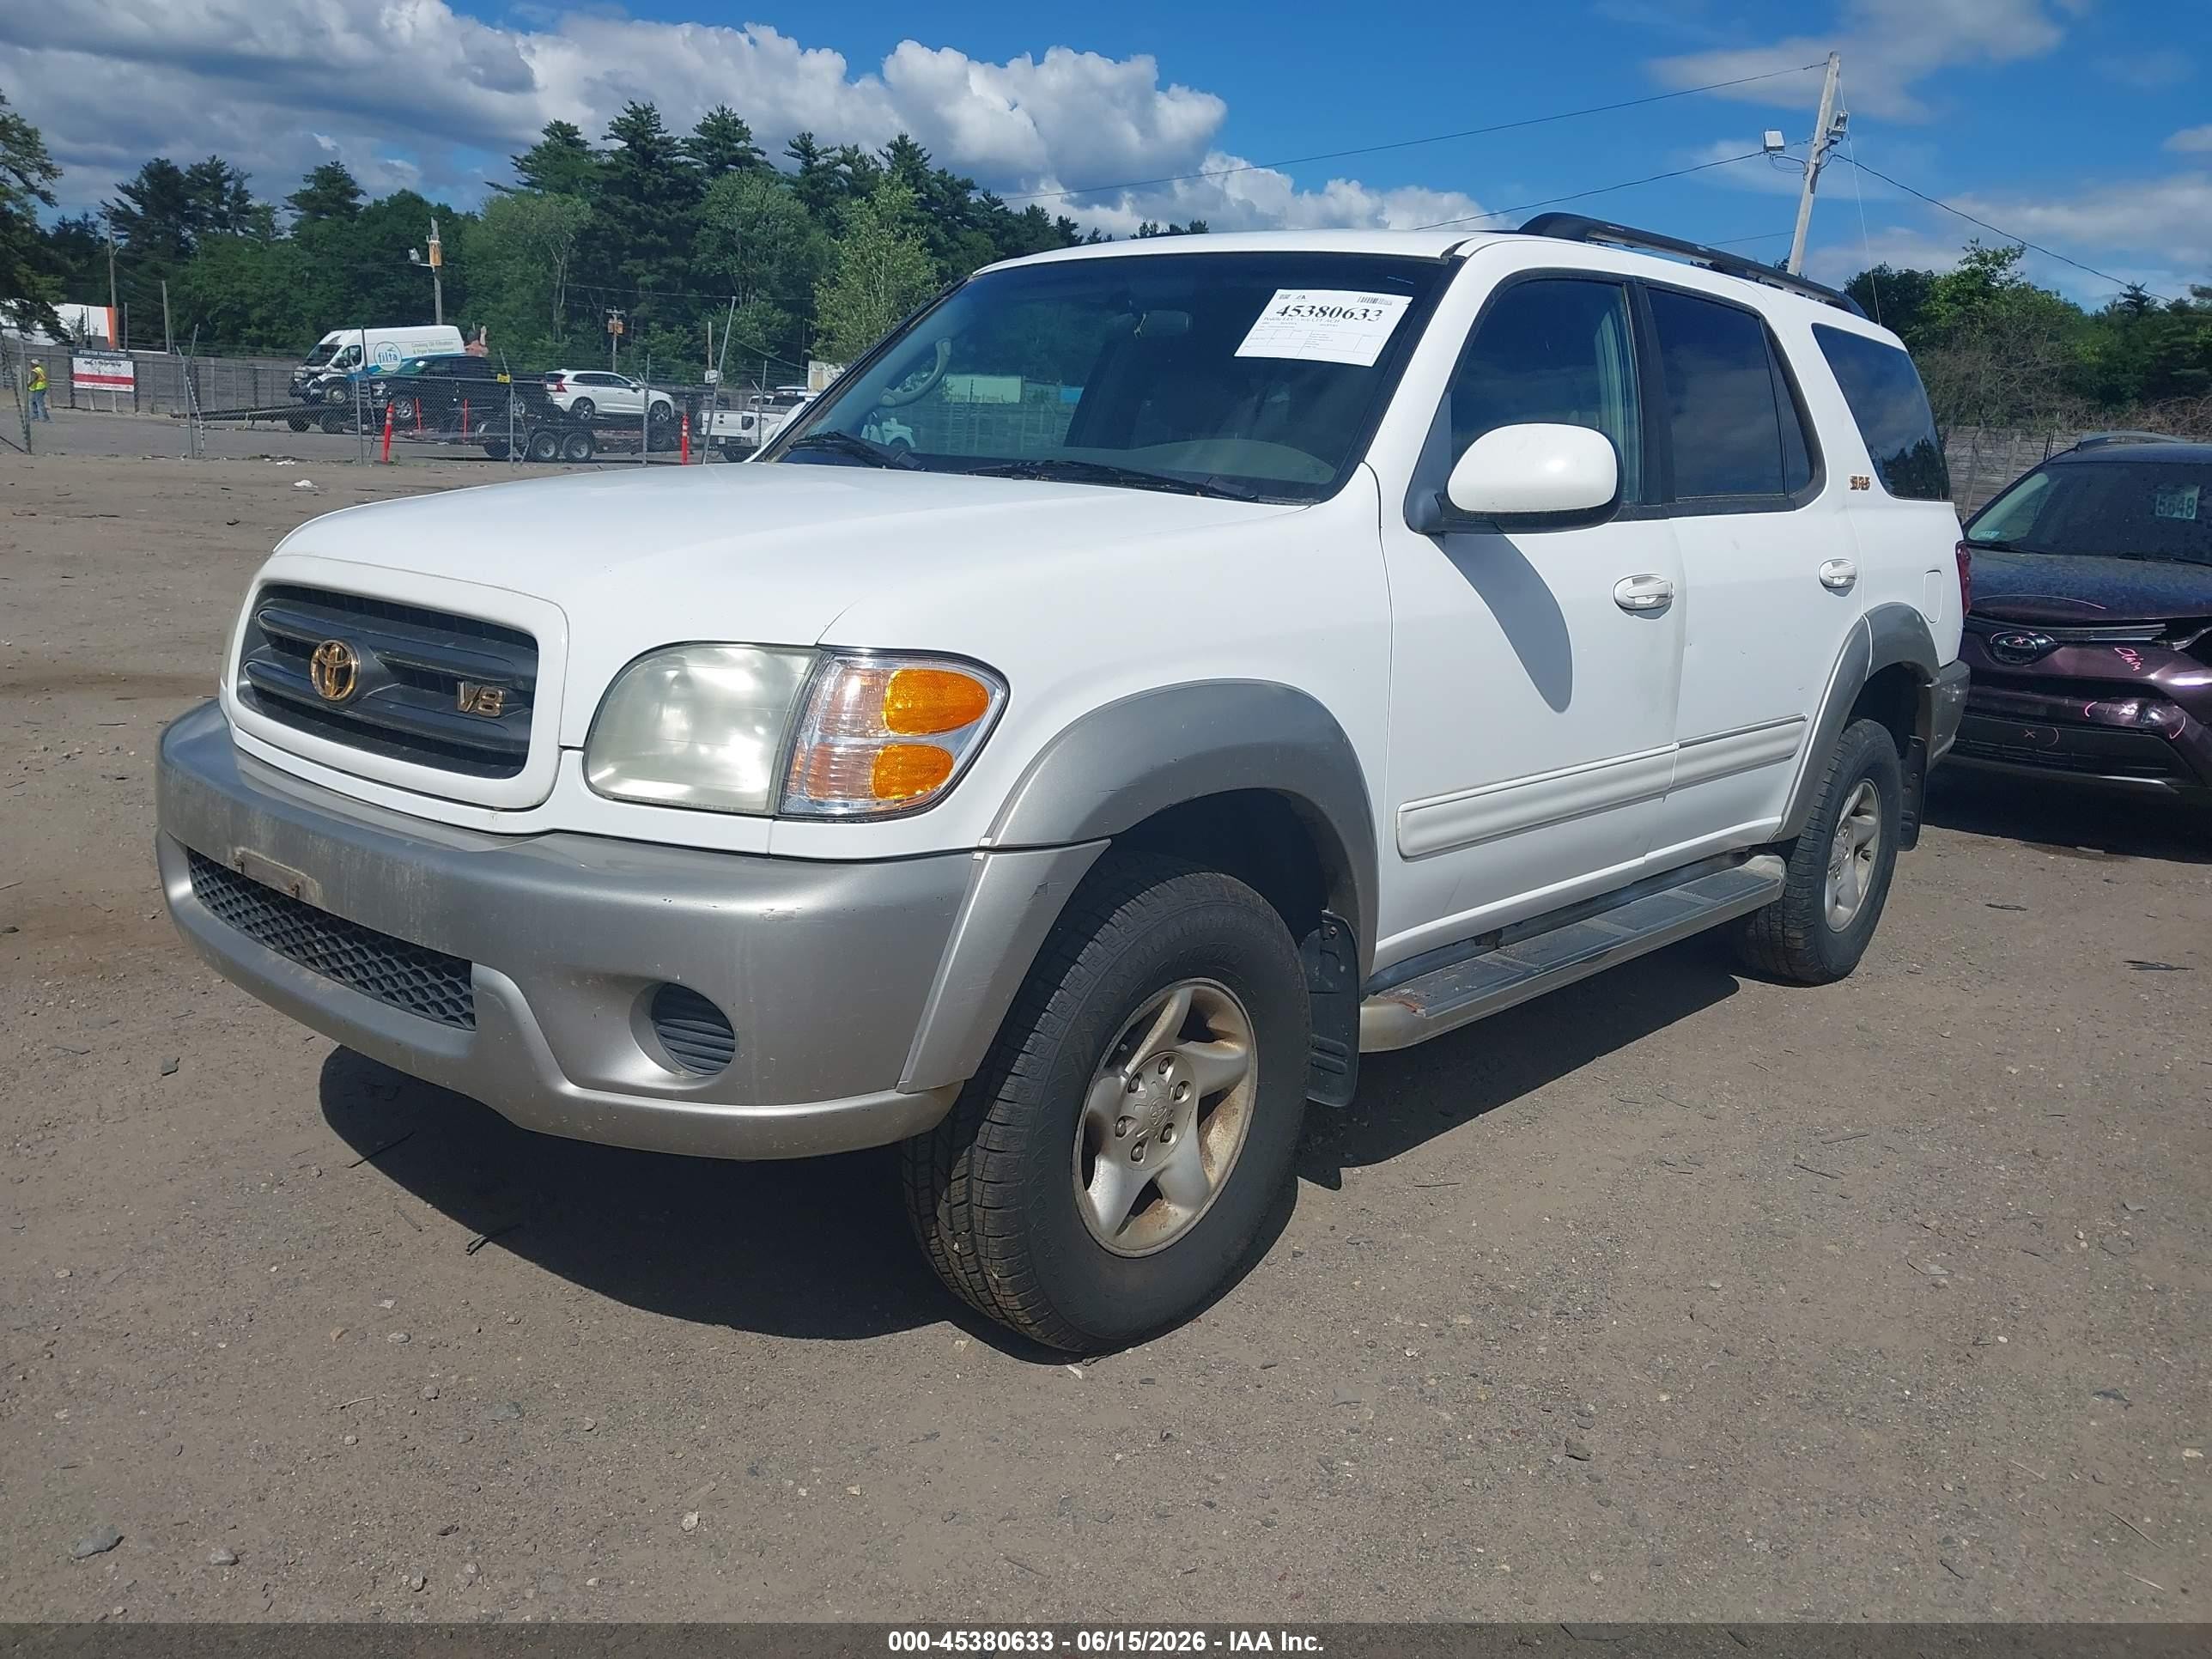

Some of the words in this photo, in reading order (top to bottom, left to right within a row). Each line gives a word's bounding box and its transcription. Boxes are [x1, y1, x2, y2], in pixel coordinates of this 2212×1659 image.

[1276, 304, 1383, 322] 45380633
[378, 351, 398, 363] filta
[1850, 475, 1870, 490] SR5
[457, 680, 506, 718] V8
